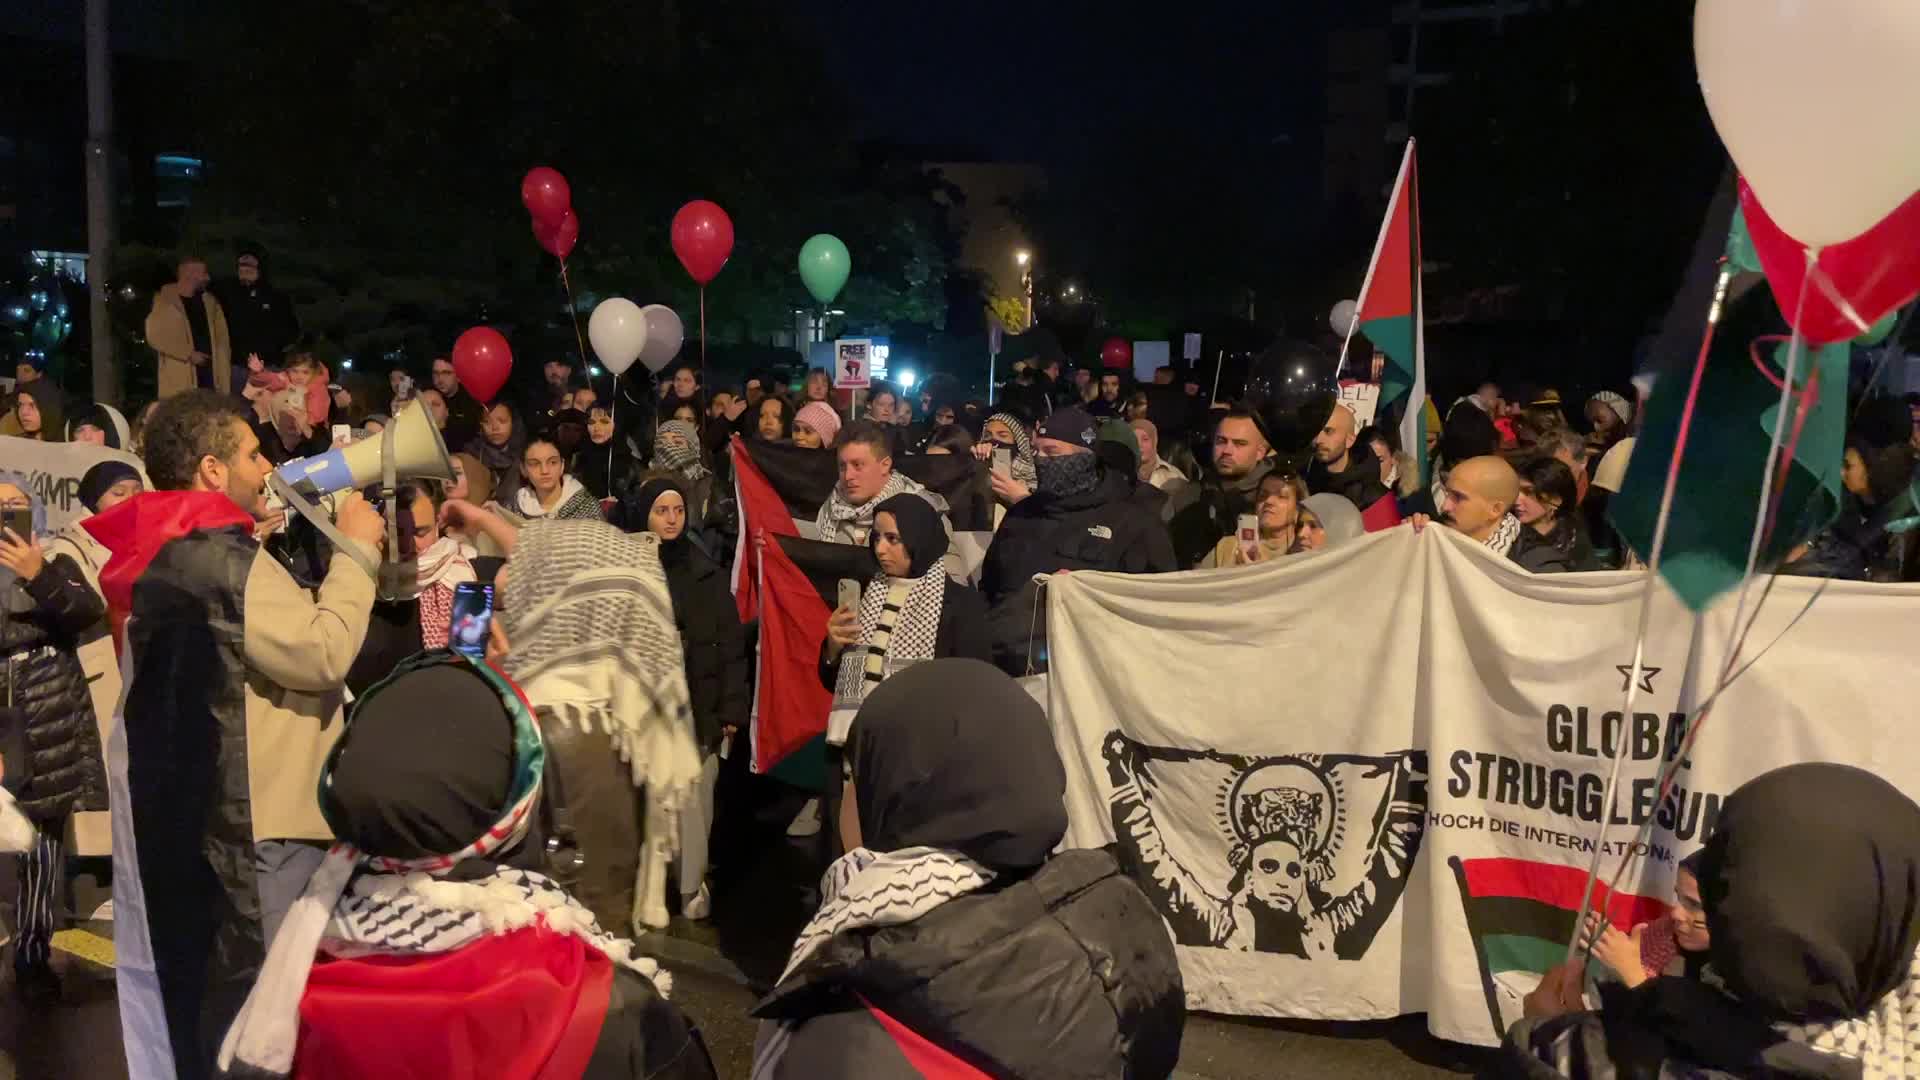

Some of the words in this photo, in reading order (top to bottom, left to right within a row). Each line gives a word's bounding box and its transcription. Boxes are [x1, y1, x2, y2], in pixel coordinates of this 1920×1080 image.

[840, 344, 866, 357] FREE
[30, 468, 81, 512] AMP
[1429, 811, 1484, 830] HOCH
[1489, 818, 1521, 837] DIE
